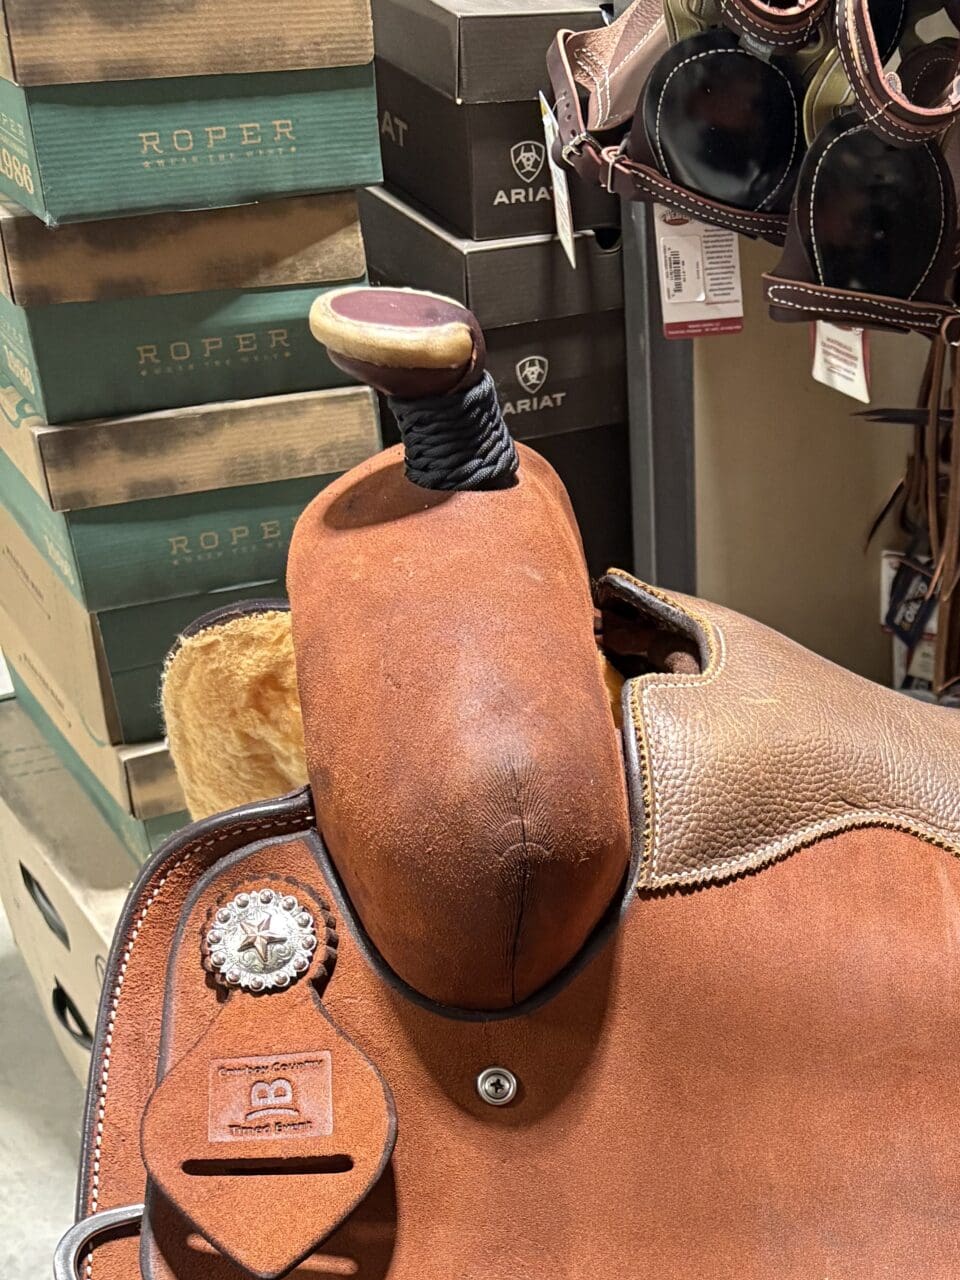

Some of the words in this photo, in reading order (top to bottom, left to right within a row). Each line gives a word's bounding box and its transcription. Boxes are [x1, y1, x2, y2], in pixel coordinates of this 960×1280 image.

[138, 119, 297, 155] ROPER
[493, 187, 554, 206] ARIA
[136, 328, 291, 365] ROPER
[501, 392, 567, 417] ARIAT
